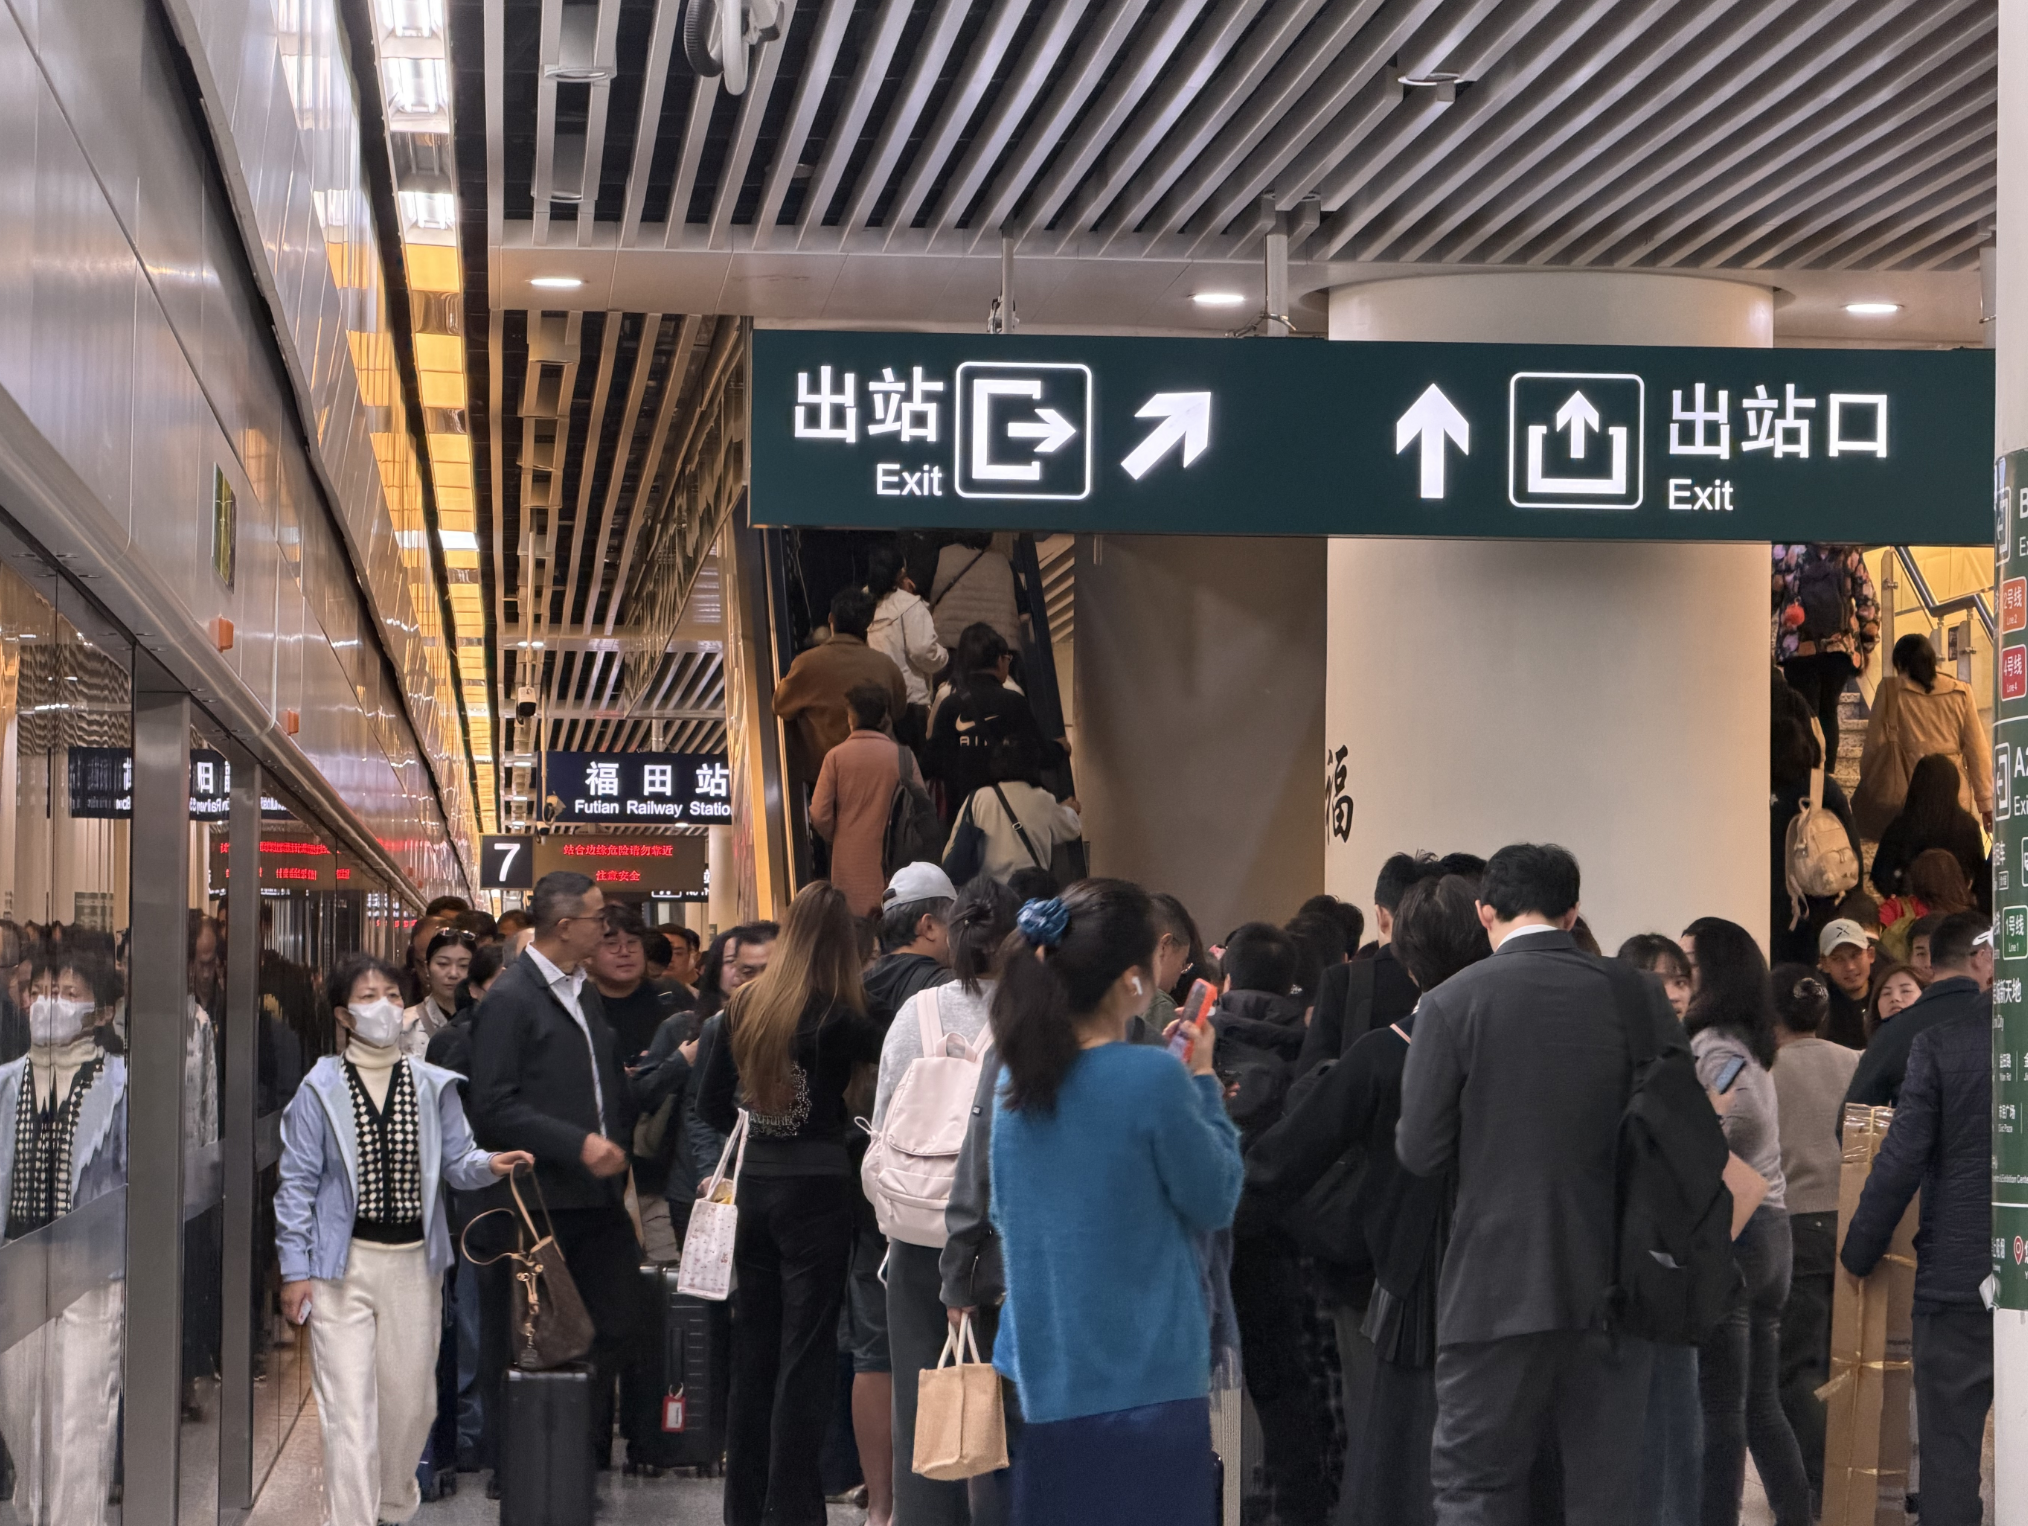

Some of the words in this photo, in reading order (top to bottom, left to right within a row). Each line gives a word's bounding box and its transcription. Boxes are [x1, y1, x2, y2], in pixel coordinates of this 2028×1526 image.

[794, 365, 944, 443] 出站
[1669, 383, 1888, 460] 出站口
[876, 463, 943, 497] Exit
[1668, 478, 1734, 511] Exit
[2003, 654, 2023, 677] 4号线
[585, 761, 729, 797] 福田站
[574, 799, 619, 814] Futian
[626, 800, 683, 818] Railway
[689, 801, 732, 816] Statio
[493, 843, 521, 882] 7
[563, 844, 674, 857] 站台边缘危险请勿靠近
[596, 870, 641, 882] 注意安全
[2005, 913, 2025, 937] 1号线
